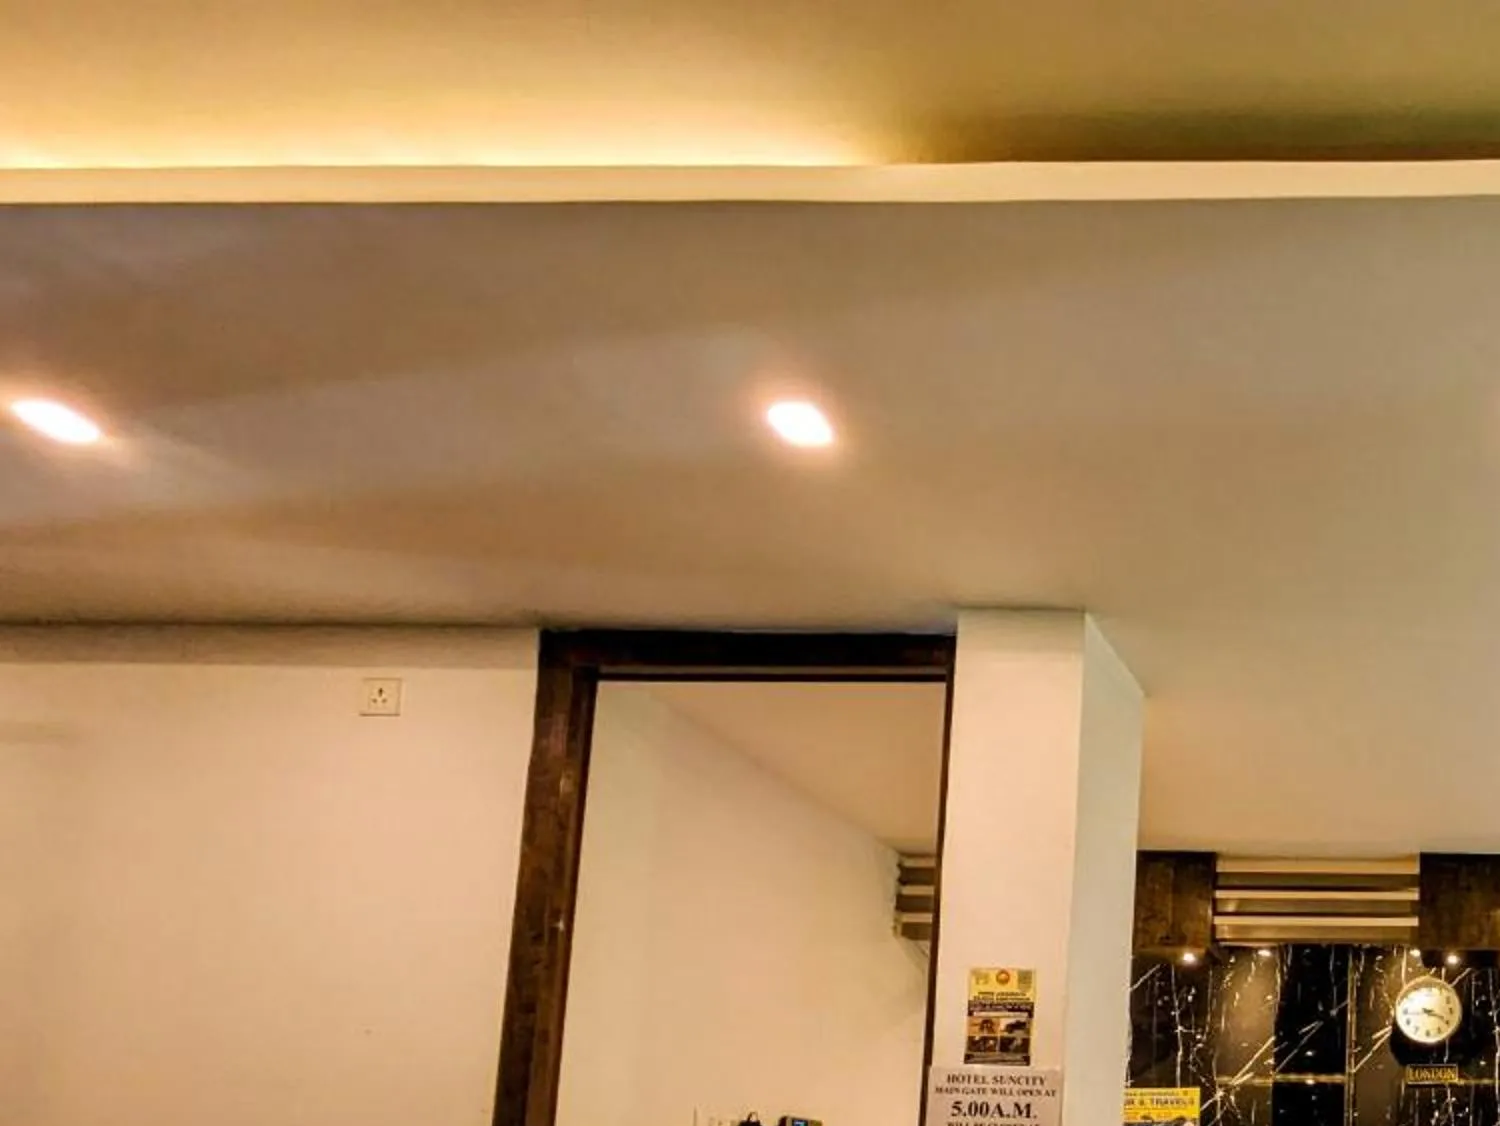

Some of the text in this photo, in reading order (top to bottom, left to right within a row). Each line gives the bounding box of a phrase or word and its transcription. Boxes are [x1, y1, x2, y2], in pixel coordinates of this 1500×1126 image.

[946, 1074, 1046, 1086] HOTEL SUNCITY
[961, 1087, 987, 1095] GATE
[991, 1088, 1014, 1096] WILL
[1045, 1089, 1057, 1097] AT
